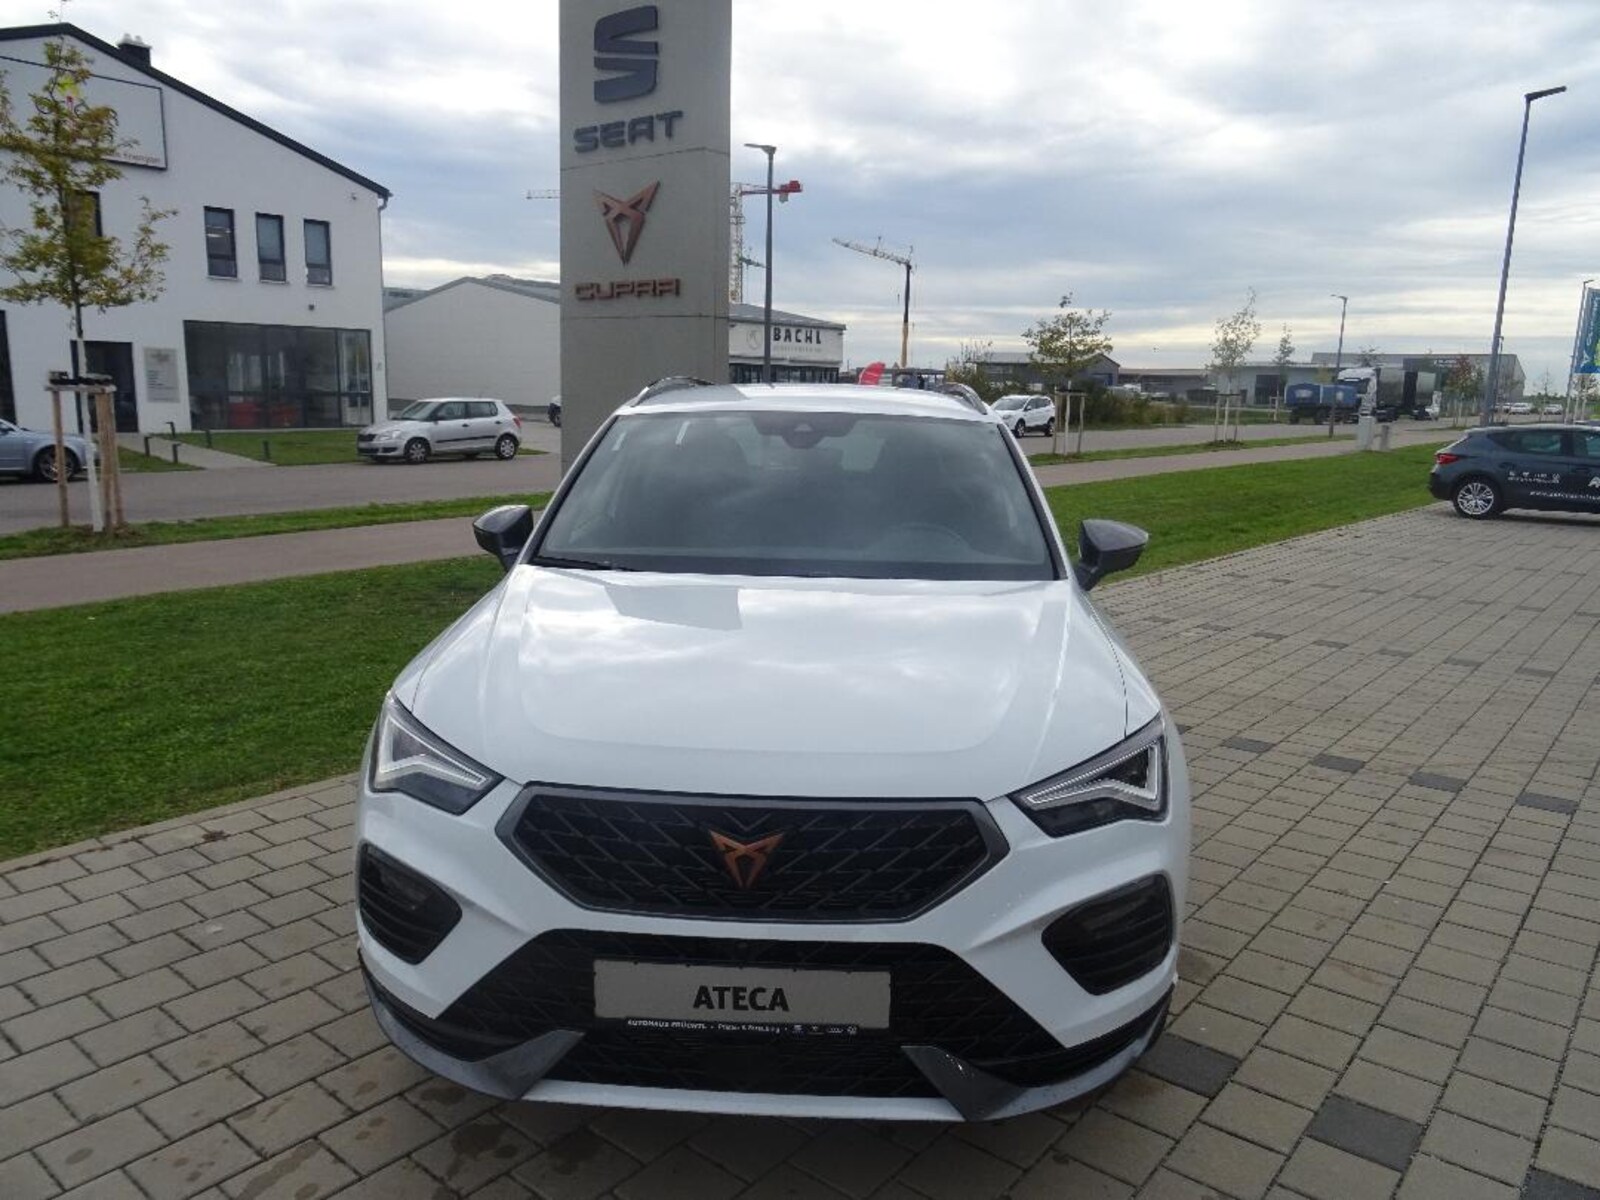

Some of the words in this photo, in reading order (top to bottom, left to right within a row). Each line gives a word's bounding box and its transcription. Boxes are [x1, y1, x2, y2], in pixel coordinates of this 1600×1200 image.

[574, 110, 684, 153] SEAT
[575, 278, 681, 301] CUPRA
[773, 327, 822, 344] BACHL
[693, 986, 789, 1012] ATECA
